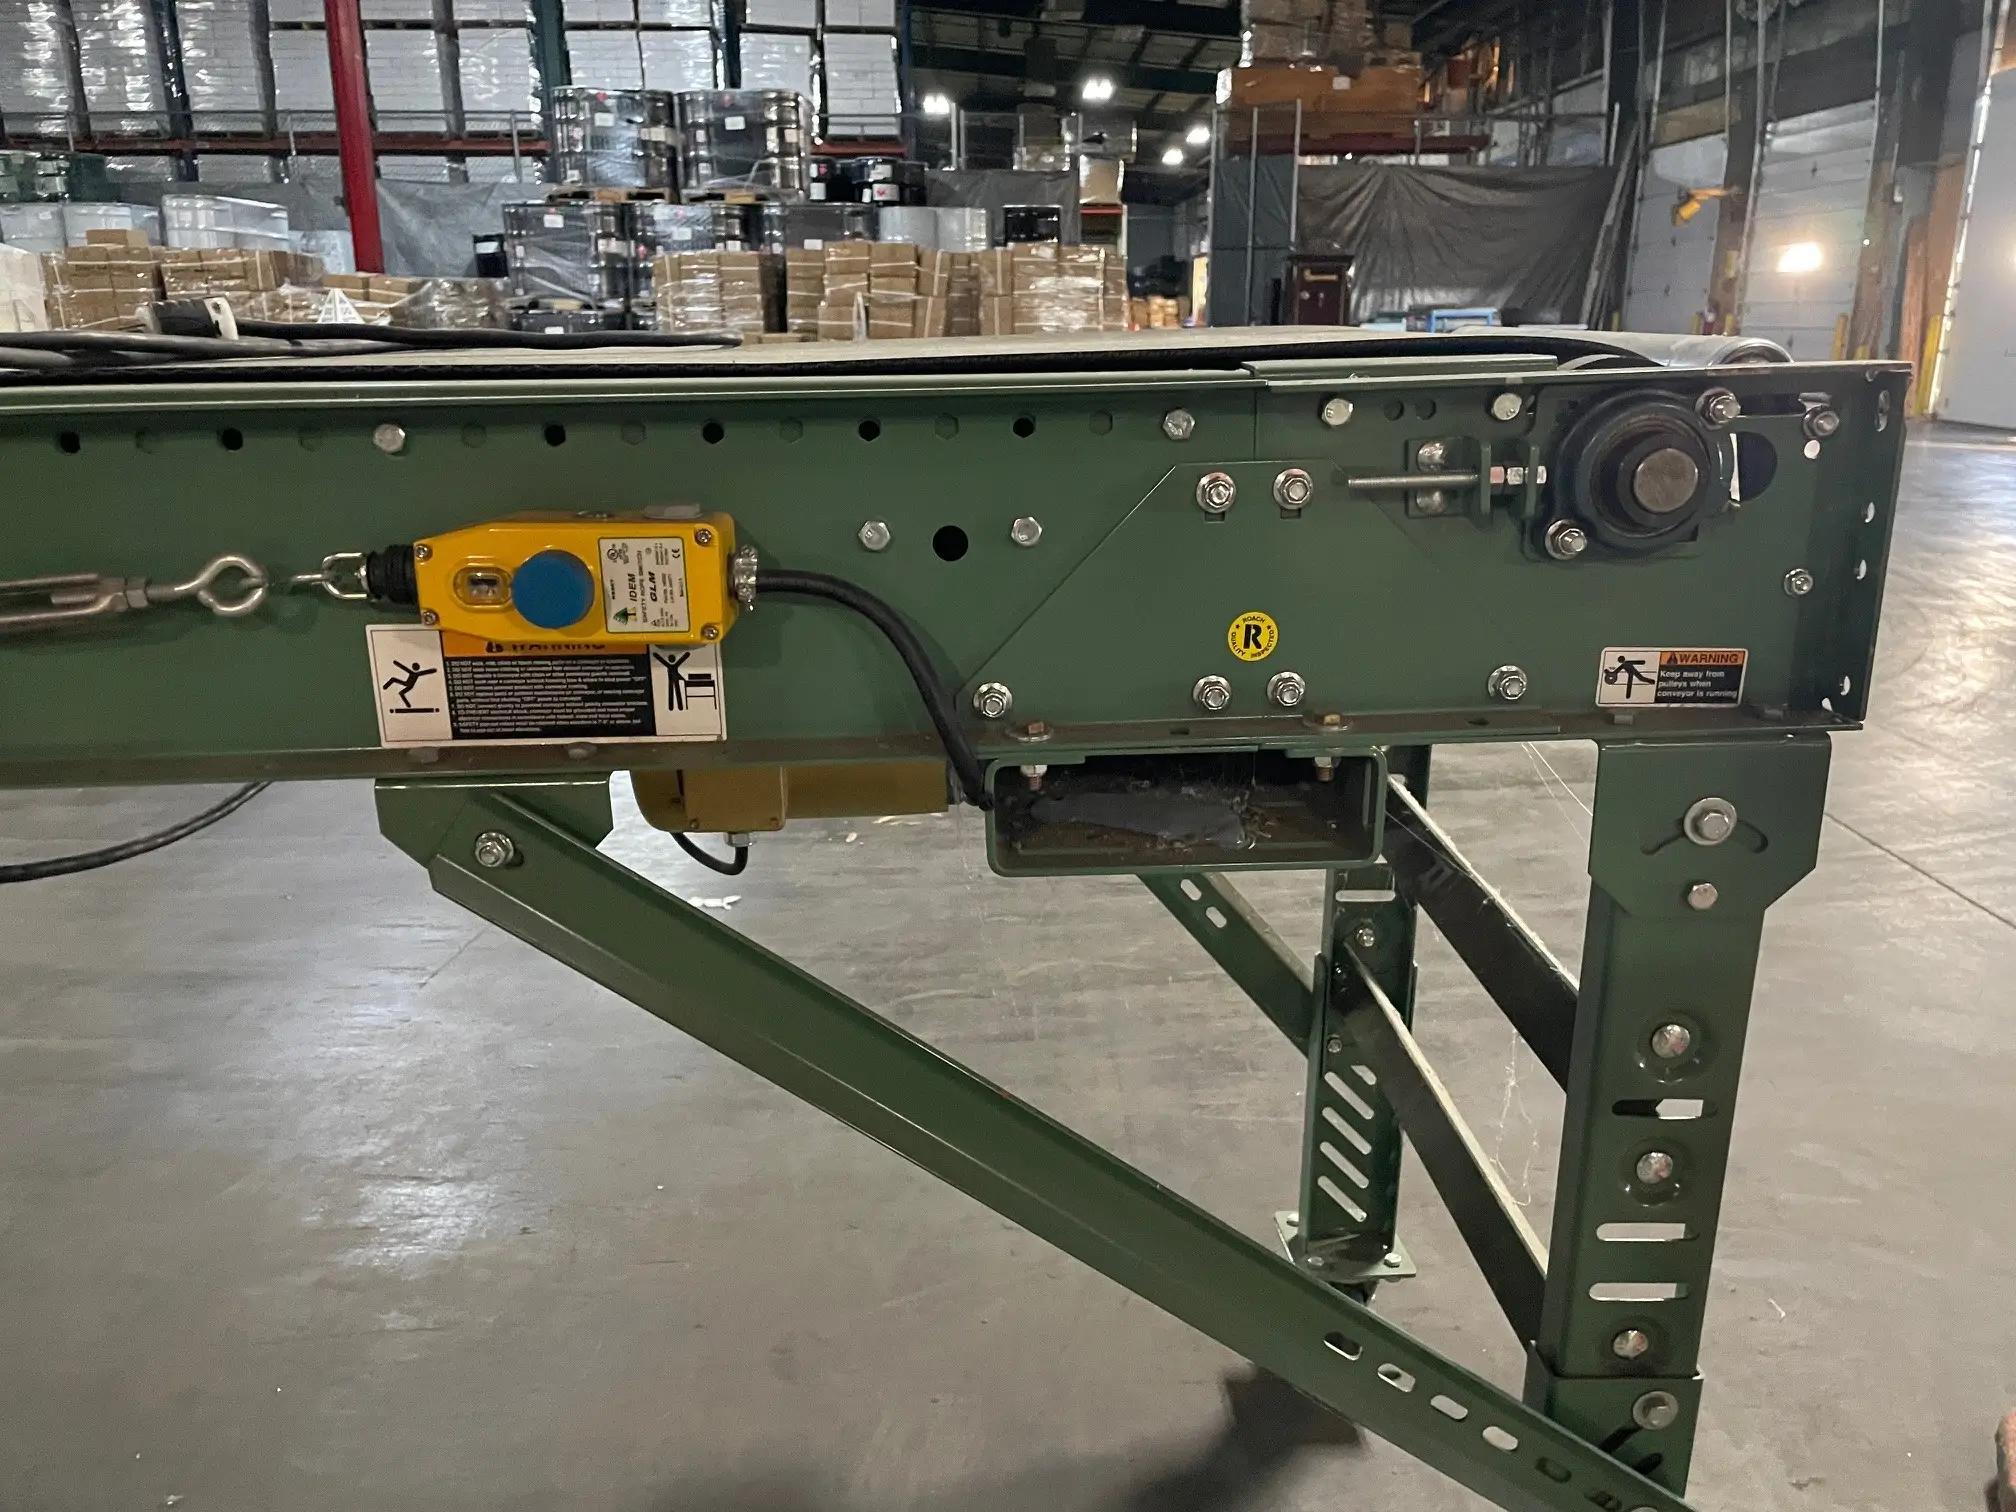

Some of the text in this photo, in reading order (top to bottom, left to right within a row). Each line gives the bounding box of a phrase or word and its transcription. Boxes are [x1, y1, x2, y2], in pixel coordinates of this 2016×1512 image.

[627, 573, 638, 602] IDEM
[648, 571, 658, 602] GLM
[1242, 615, 1266, 623] ROACH
[1243, 624, 1262, 649] R
[1231, 632, 1246, 656] QUALITY
[1679, 653, 1739, 664] WARNING
[1660, 670, 1681, 678] Keep
[1683, 671, 1704, 679] away
[1658, 680, 1688, 688] pulleys
[1706, 690, 1738, 698] running
